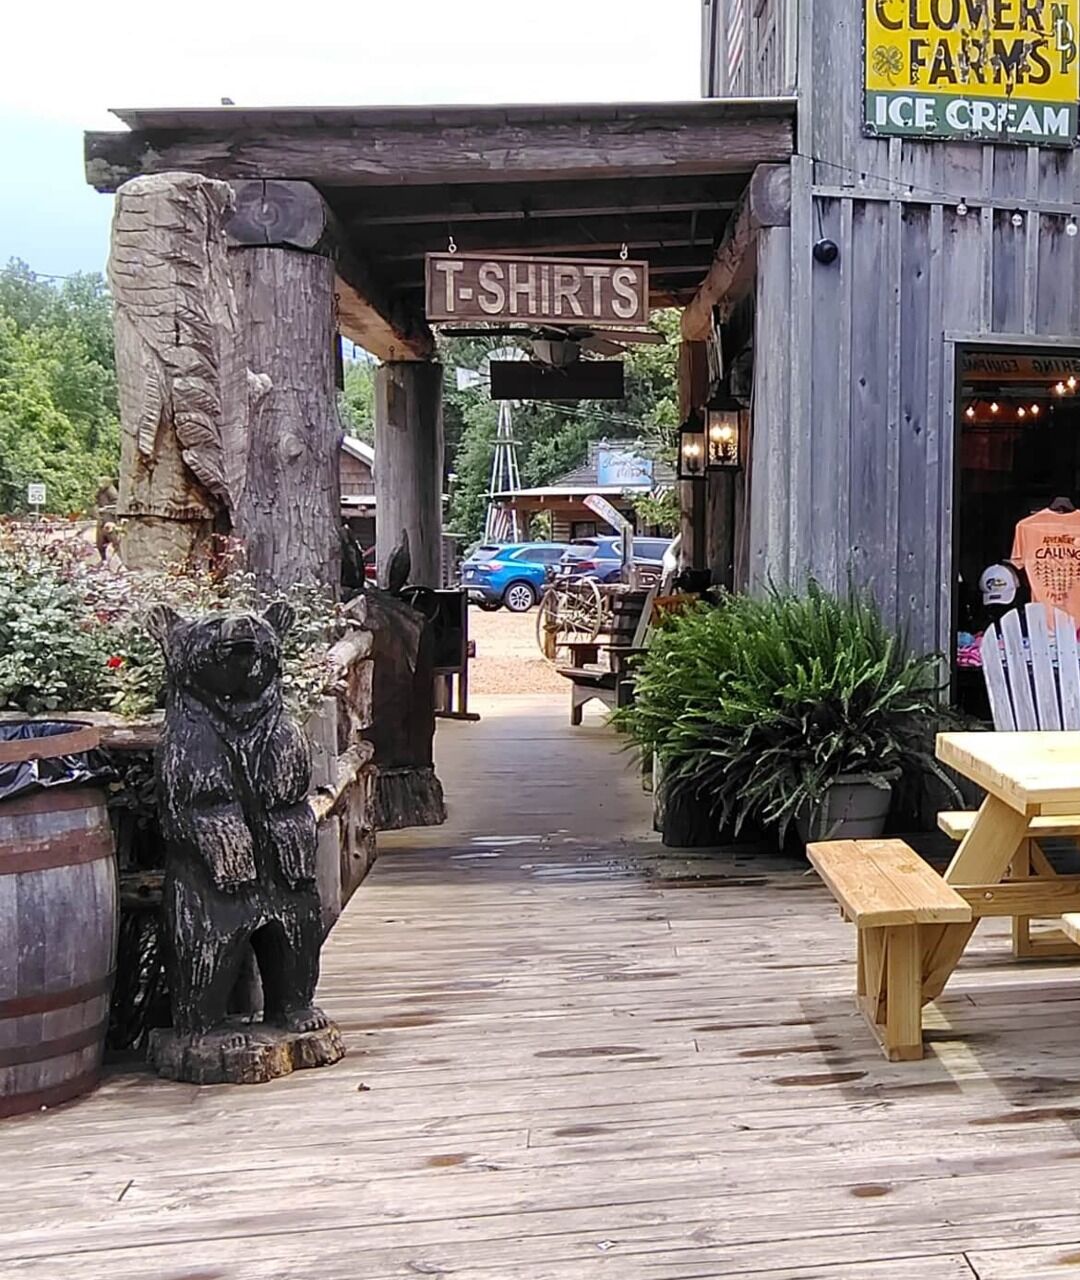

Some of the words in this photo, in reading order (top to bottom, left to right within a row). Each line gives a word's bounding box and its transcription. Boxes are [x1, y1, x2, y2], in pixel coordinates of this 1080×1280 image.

[908, 38, 1051, 85] FARMS
[875, 95, 936, 128] ICE
[945, 99, 1070, 137] CREAM
[436, 260, 639, 319] T-SHIRTS
